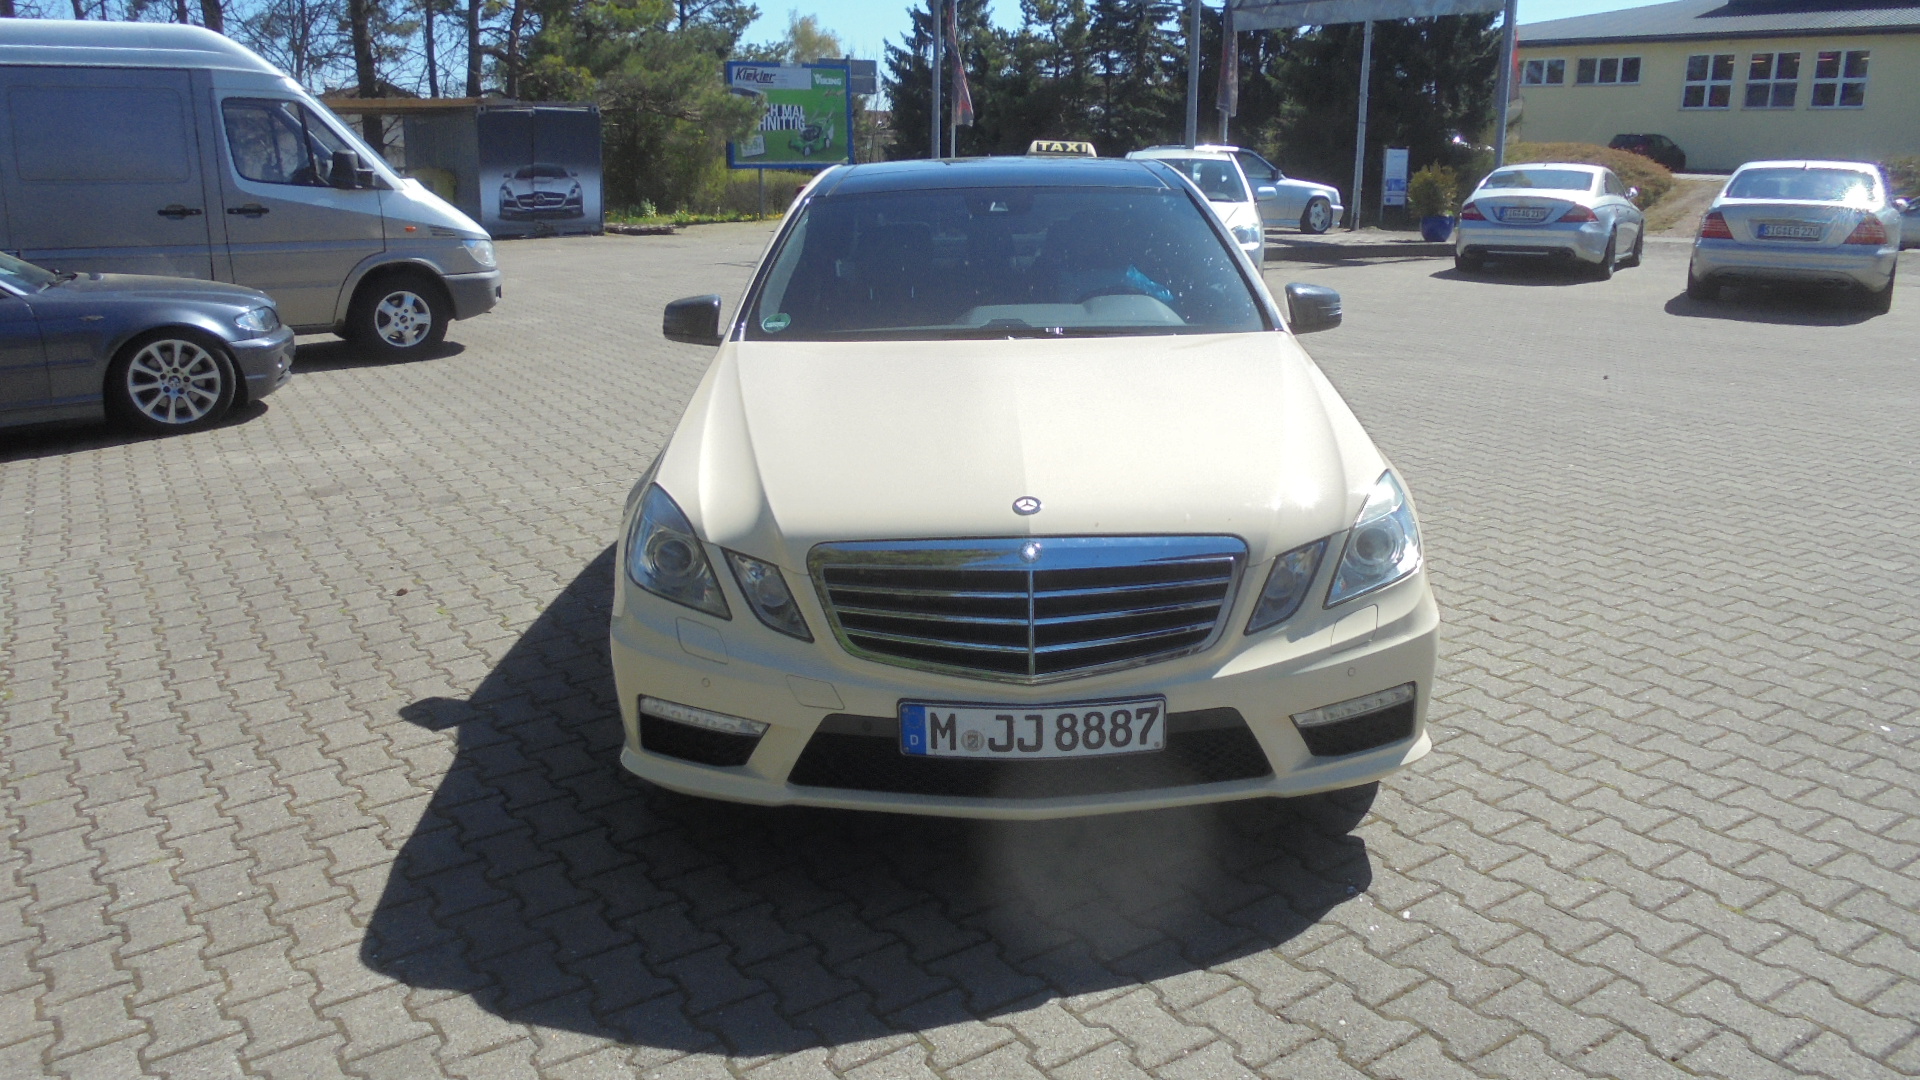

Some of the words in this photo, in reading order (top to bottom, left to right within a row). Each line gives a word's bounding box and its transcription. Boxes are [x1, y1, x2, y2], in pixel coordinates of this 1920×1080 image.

[782, 104, 805, 118] MAL
[758, 116, 806, 132] HNITTIG
[1038, 142, 1087, 153] TAXI
[930, 712, 957, 751] M
[987, 714, 1044, 753] JJ
[1054, 706, 1161, 752] 8887
[909, 734, 919, 746] D
